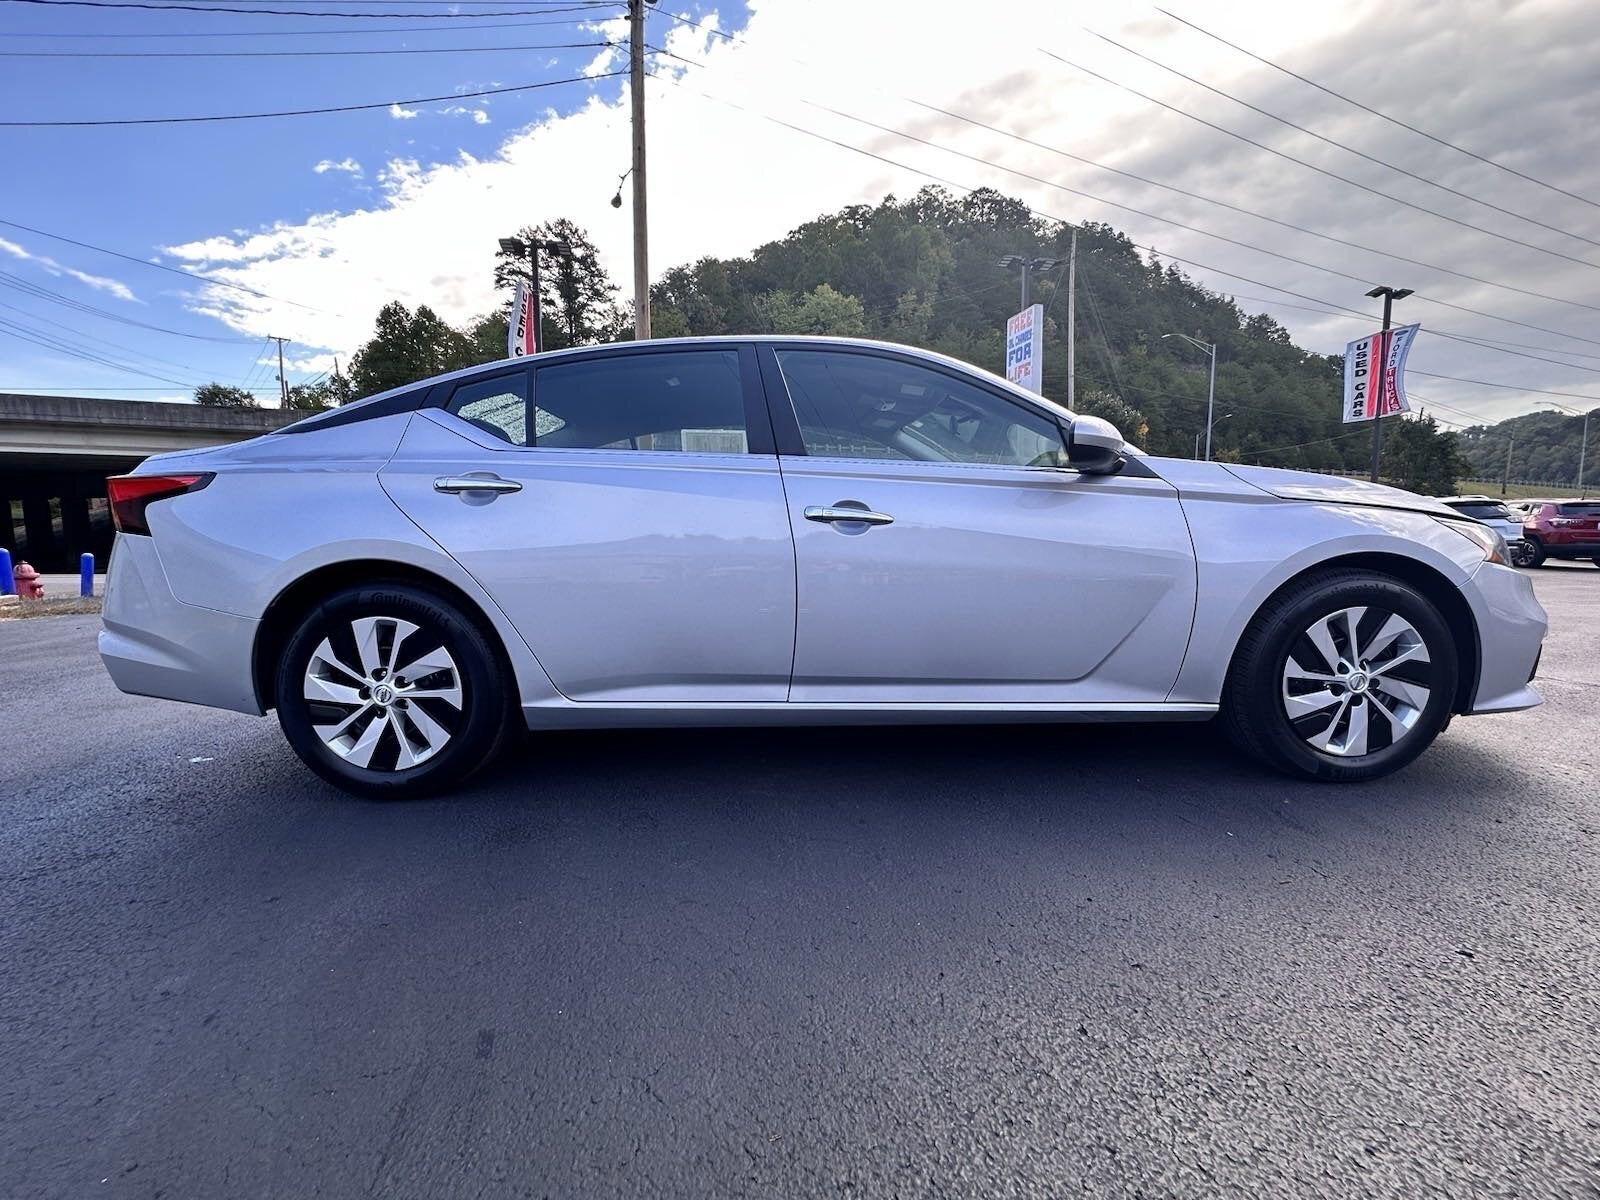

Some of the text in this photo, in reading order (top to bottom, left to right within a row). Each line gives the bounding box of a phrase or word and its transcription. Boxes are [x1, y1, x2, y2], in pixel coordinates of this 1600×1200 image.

[517, 291, 527, 338] USED
[1009, 309, 1033, 337] FREE
[1009, 342, 1031, 367] FOR
[1389, 336, 1402, 367] FORD
[1008, 362, 1031, 383] LIFE
[1352, 342, 1368, 417] USED CARS
